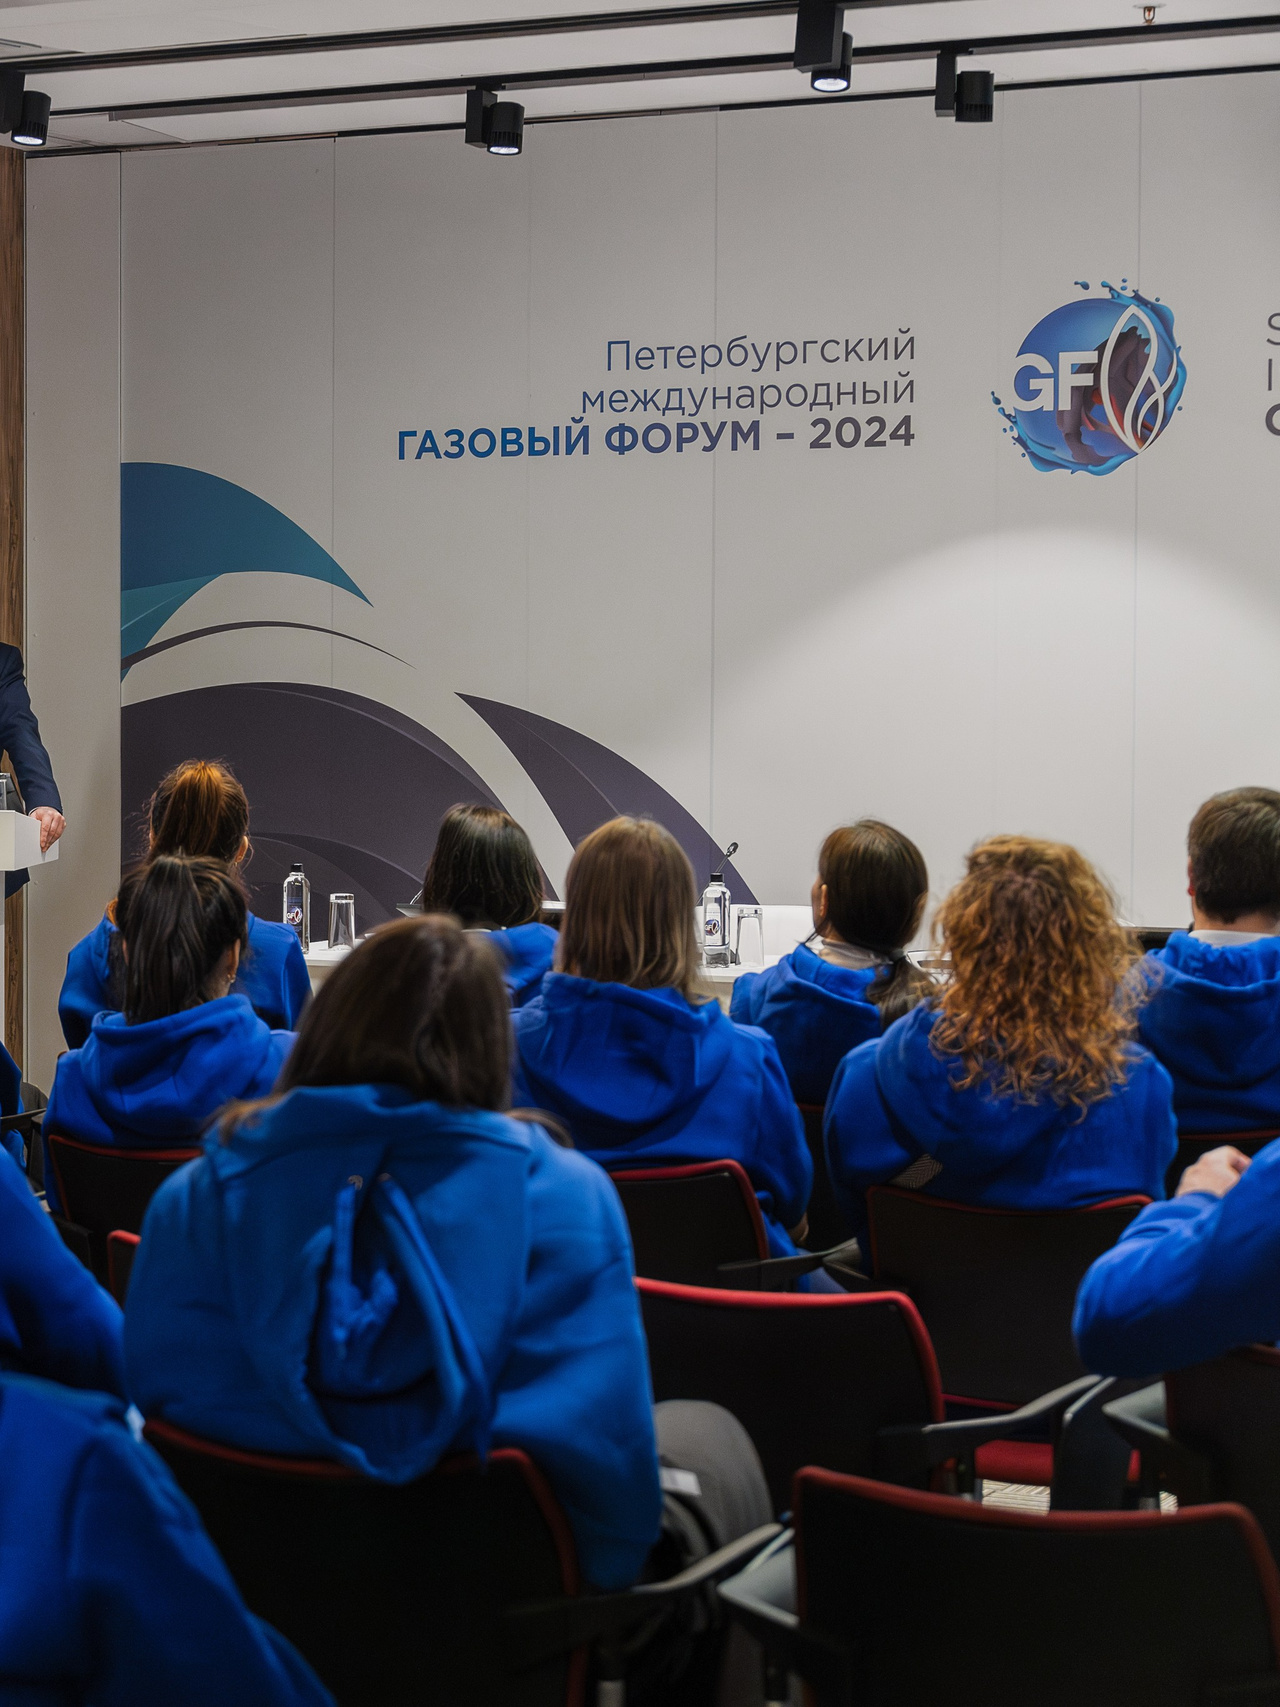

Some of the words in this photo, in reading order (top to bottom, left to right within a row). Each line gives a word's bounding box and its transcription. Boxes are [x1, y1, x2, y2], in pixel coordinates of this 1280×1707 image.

[607, 327, 915, 375] Петербургский
[582, 370, 915, 417] международный
[1006, 350, 1099, 412] GF
[398, 416, 590, 461] ГАЗОВЫЙ
[604, 419, 761, 456] ФОРУМ
[809, 415, 915, 450] 2024
